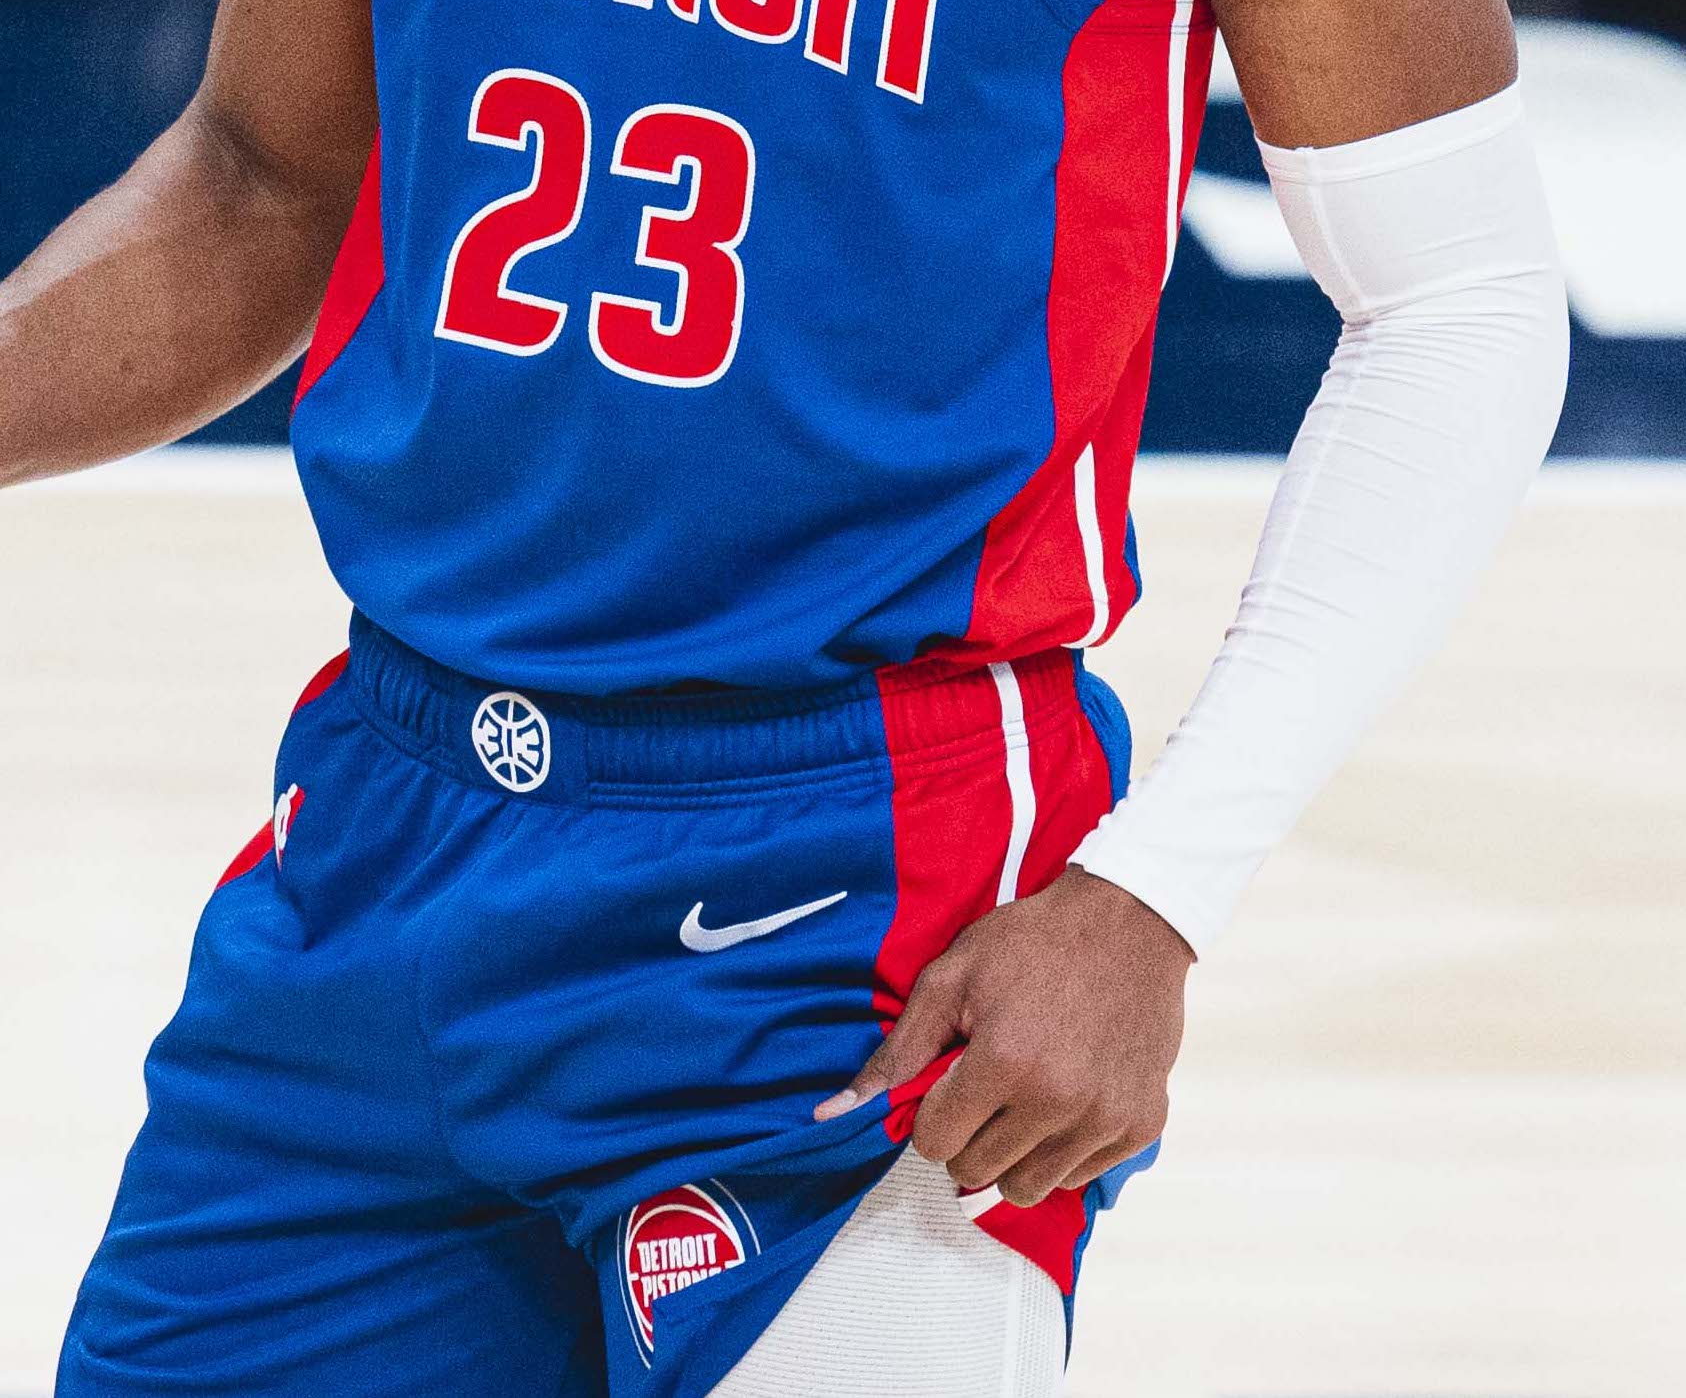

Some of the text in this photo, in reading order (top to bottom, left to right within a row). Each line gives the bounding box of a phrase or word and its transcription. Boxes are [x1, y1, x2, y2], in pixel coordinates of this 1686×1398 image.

[434, 68, 756, 387] 23
[636, 1233, 718, 1273] DETROIT
[640, 1266, 722, 1308] PISTO
